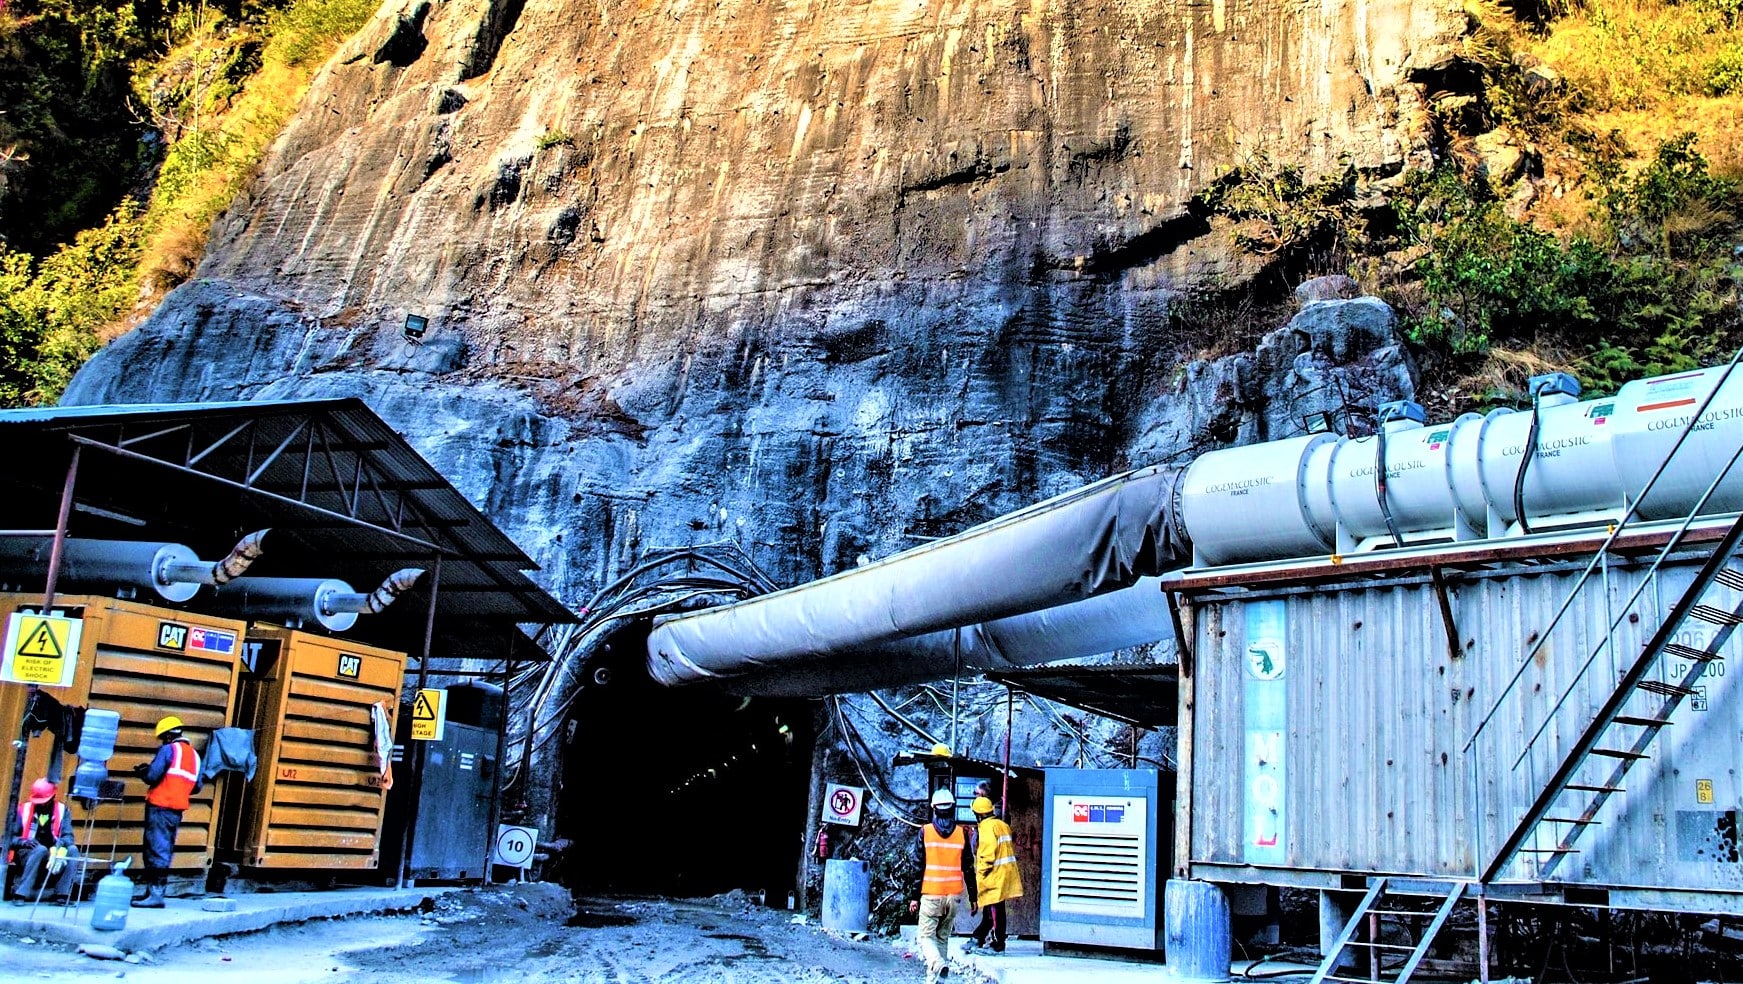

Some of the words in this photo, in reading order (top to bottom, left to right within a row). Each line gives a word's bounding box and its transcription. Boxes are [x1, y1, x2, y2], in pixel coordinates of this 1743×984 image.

[1230, 488, 1249, 497] FRANCE
[160, 624, 187, 649] CAT
[25, 658, 41, 666] RISK
[339, 655, 360, 677] CAT
[21, 665, 55, 673] ELECTRIC
[506, 839, 524, 853] 10
